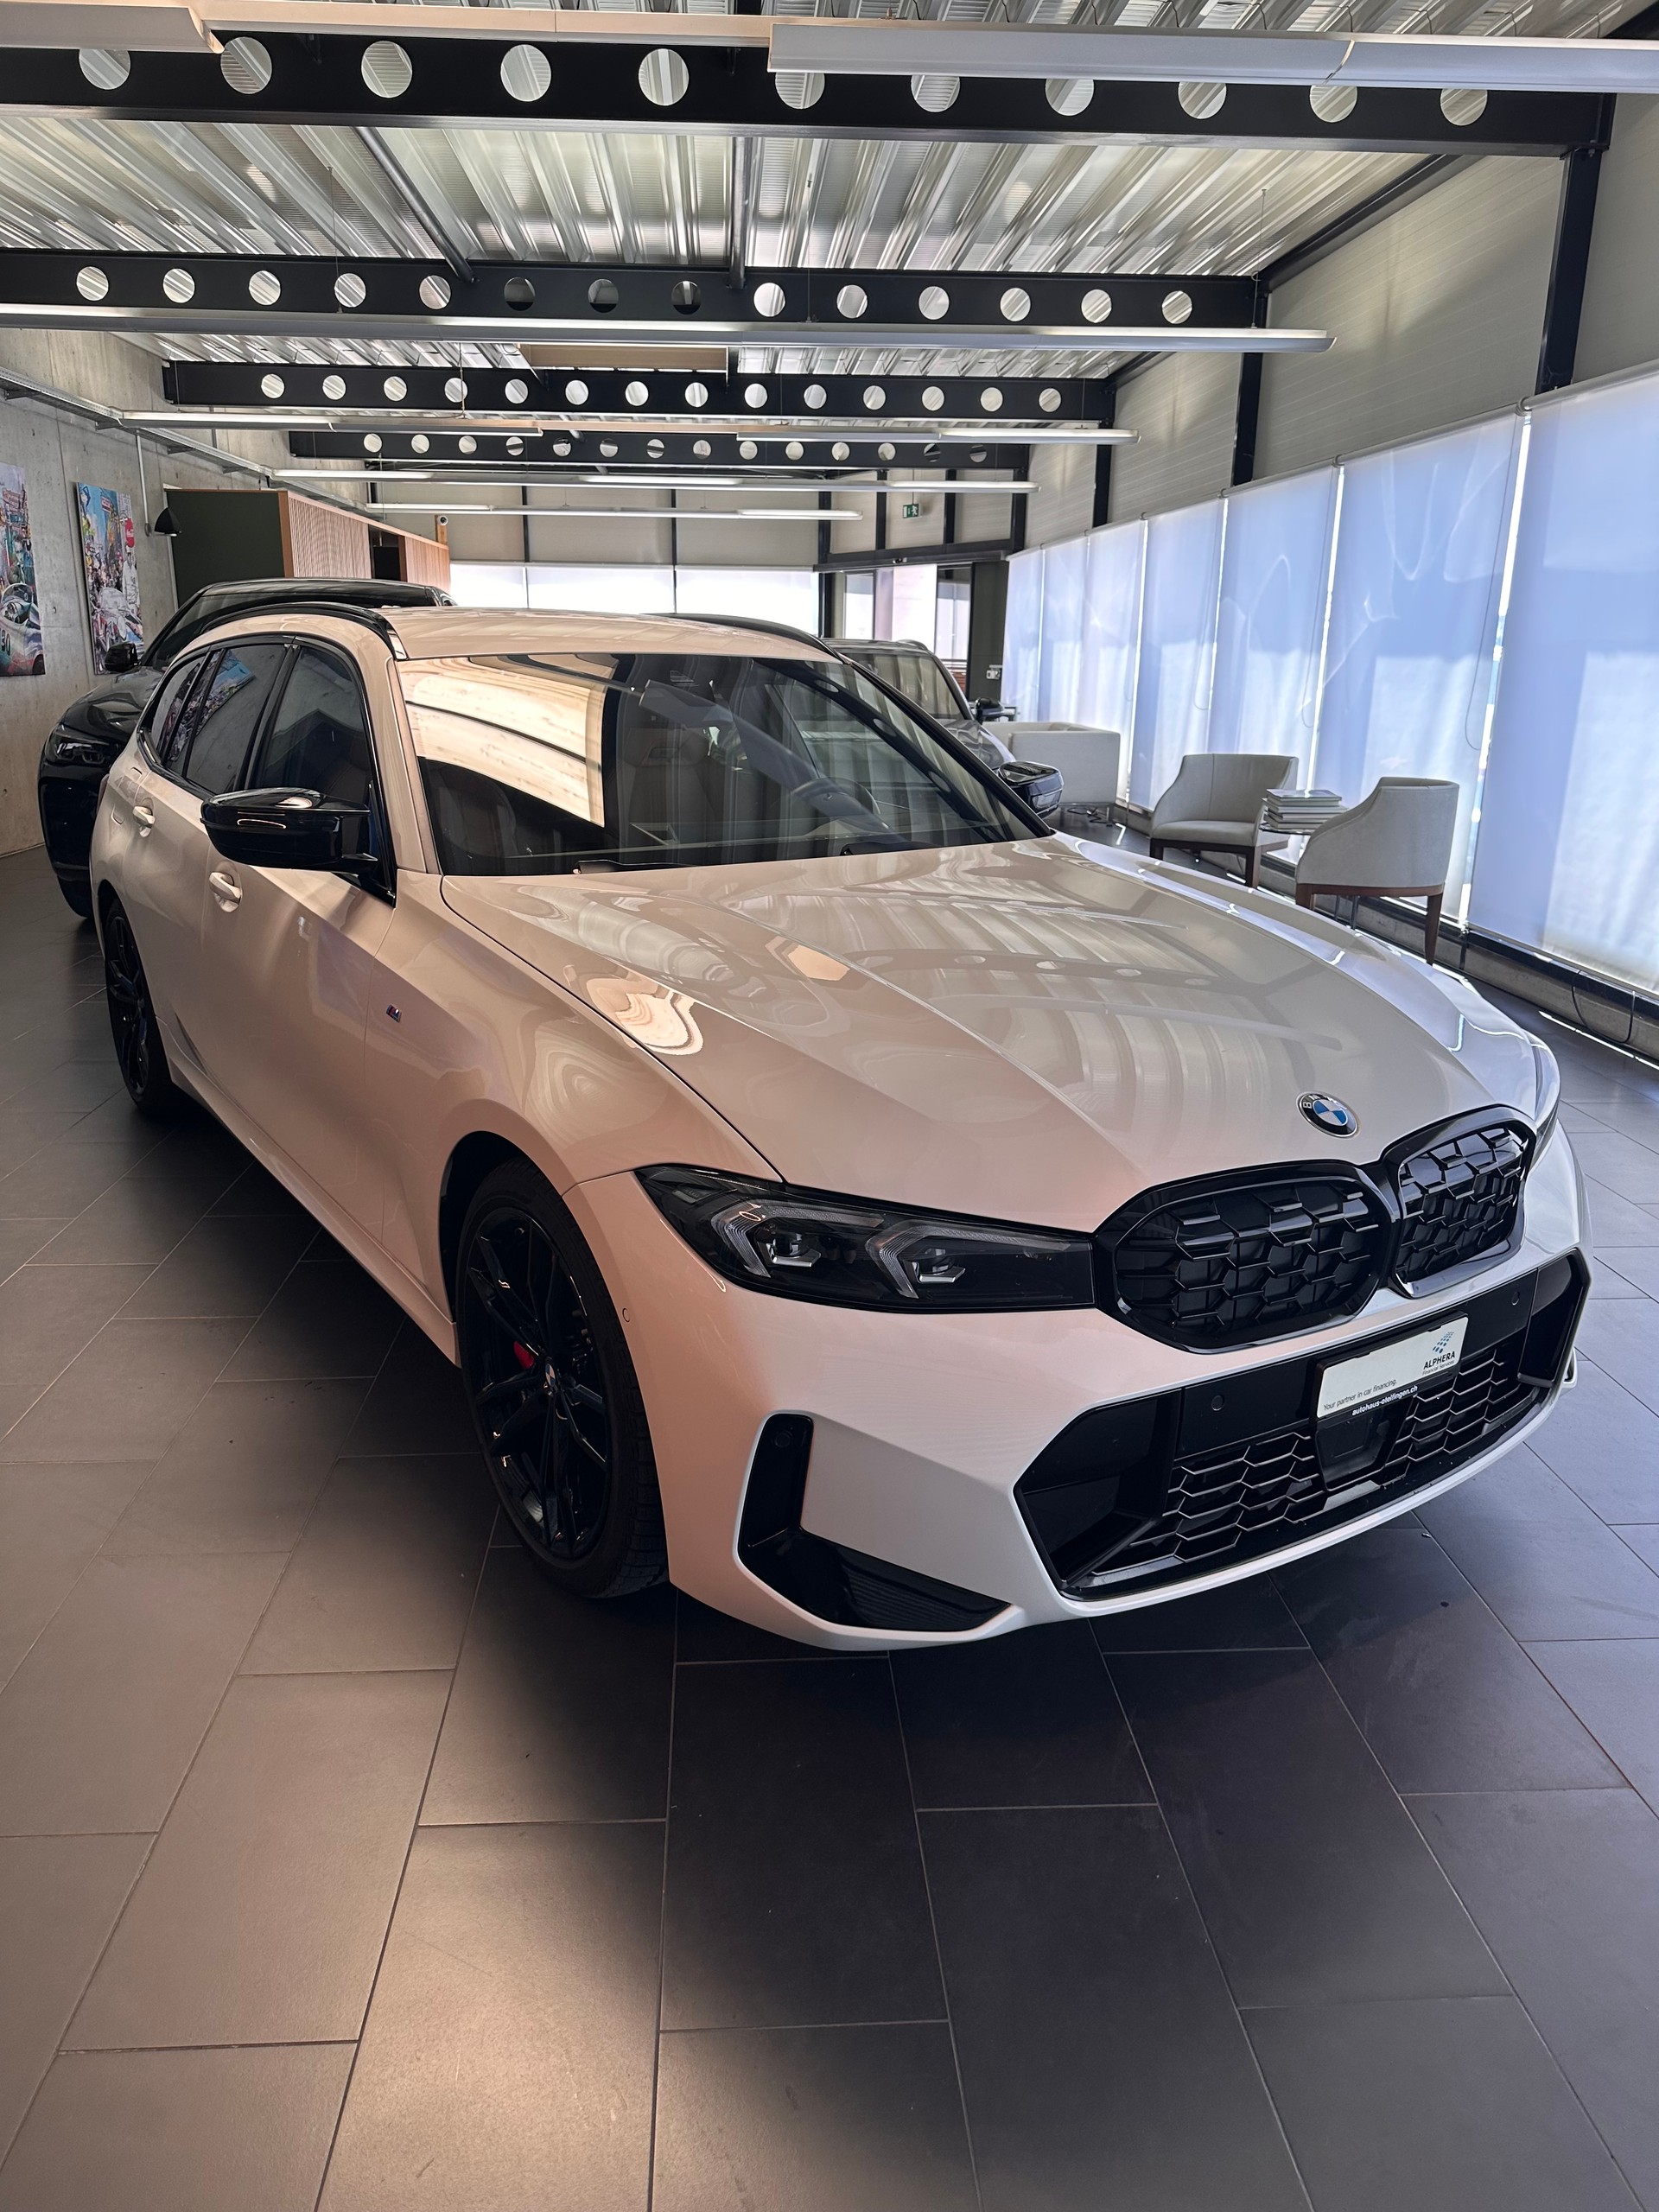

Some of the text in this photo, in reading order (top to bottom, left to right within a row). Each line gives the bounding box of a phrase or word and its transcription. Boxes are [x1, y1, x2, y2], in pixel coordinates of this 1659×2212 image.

[1422, 1360, 1455, 1375] Financial Services
[1423, 1351, 1455, 1370] ALPHERA
[1336, 1394, 1357, 1408] partner
